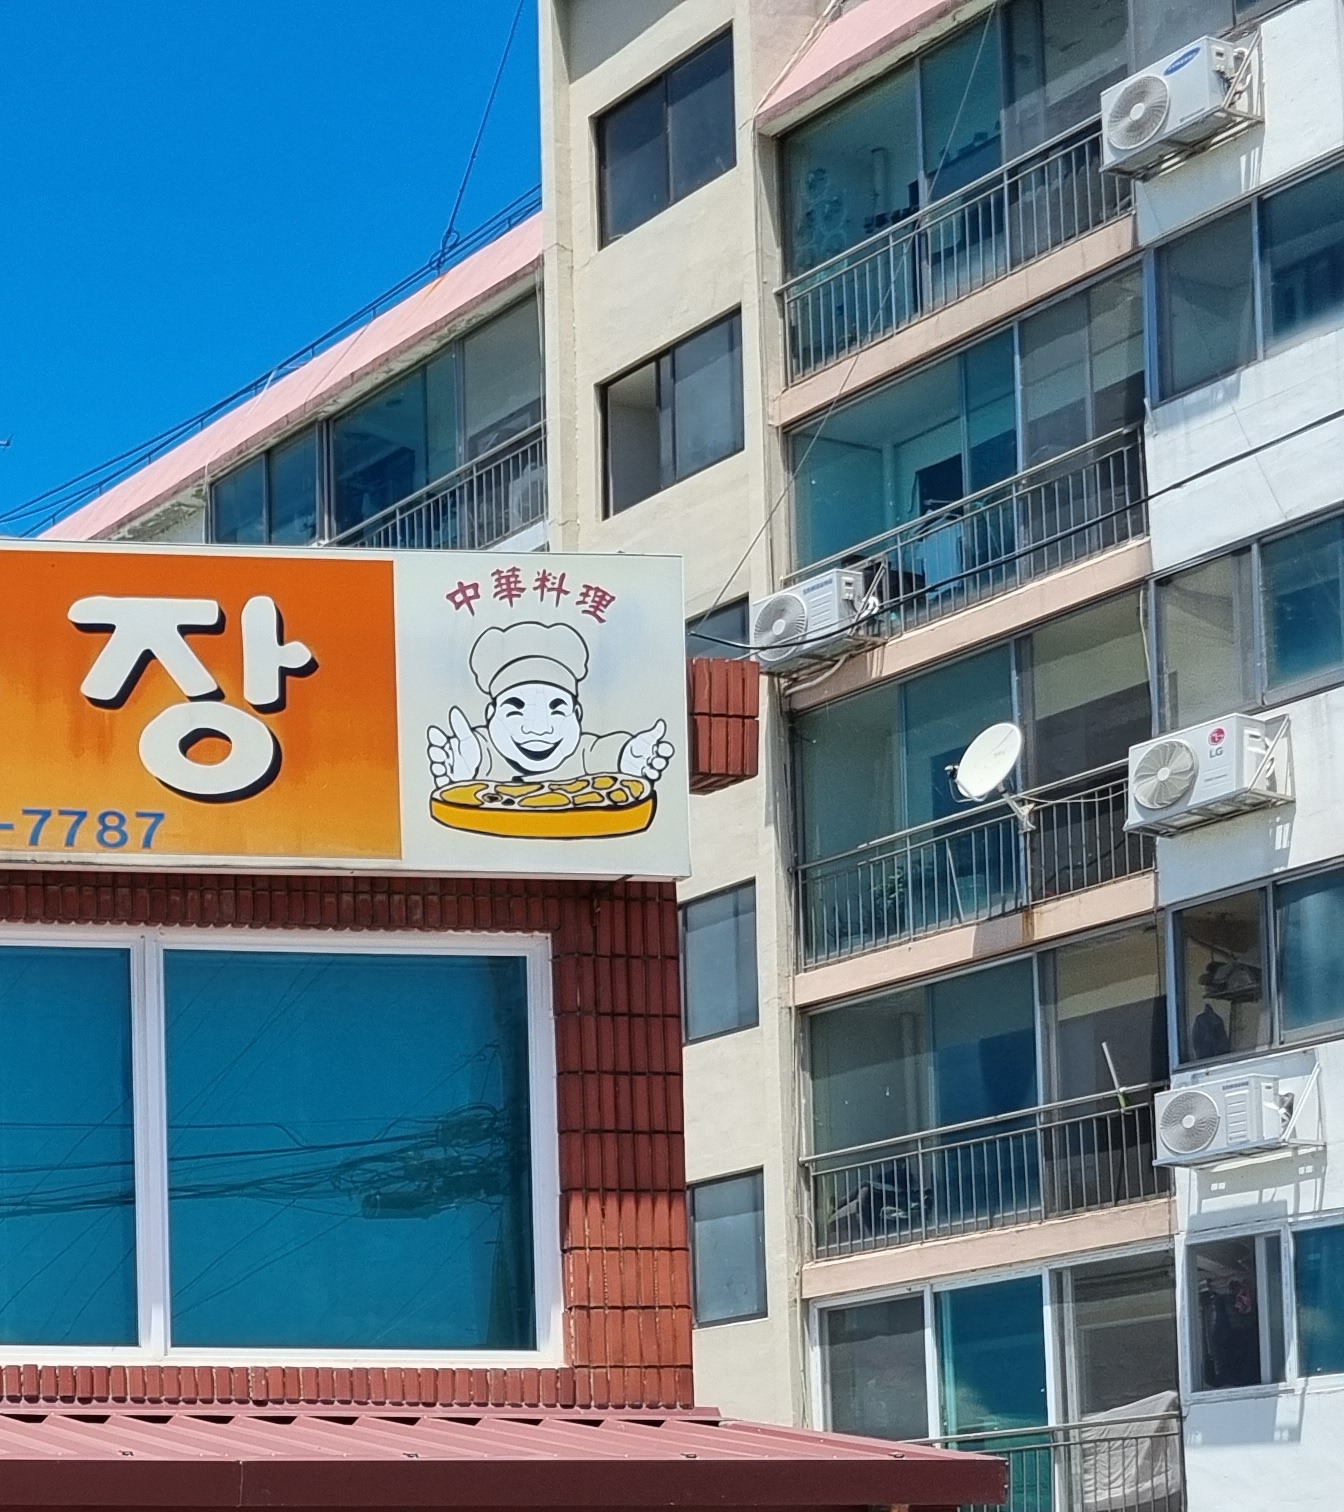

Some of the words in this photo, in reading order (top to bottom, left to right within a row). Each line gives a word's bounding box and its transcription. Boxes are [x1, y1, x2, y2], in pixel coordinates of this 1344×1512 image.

[446, 566, 616, 624] 中華料理
[1209, 746, 1224, 758] LG
